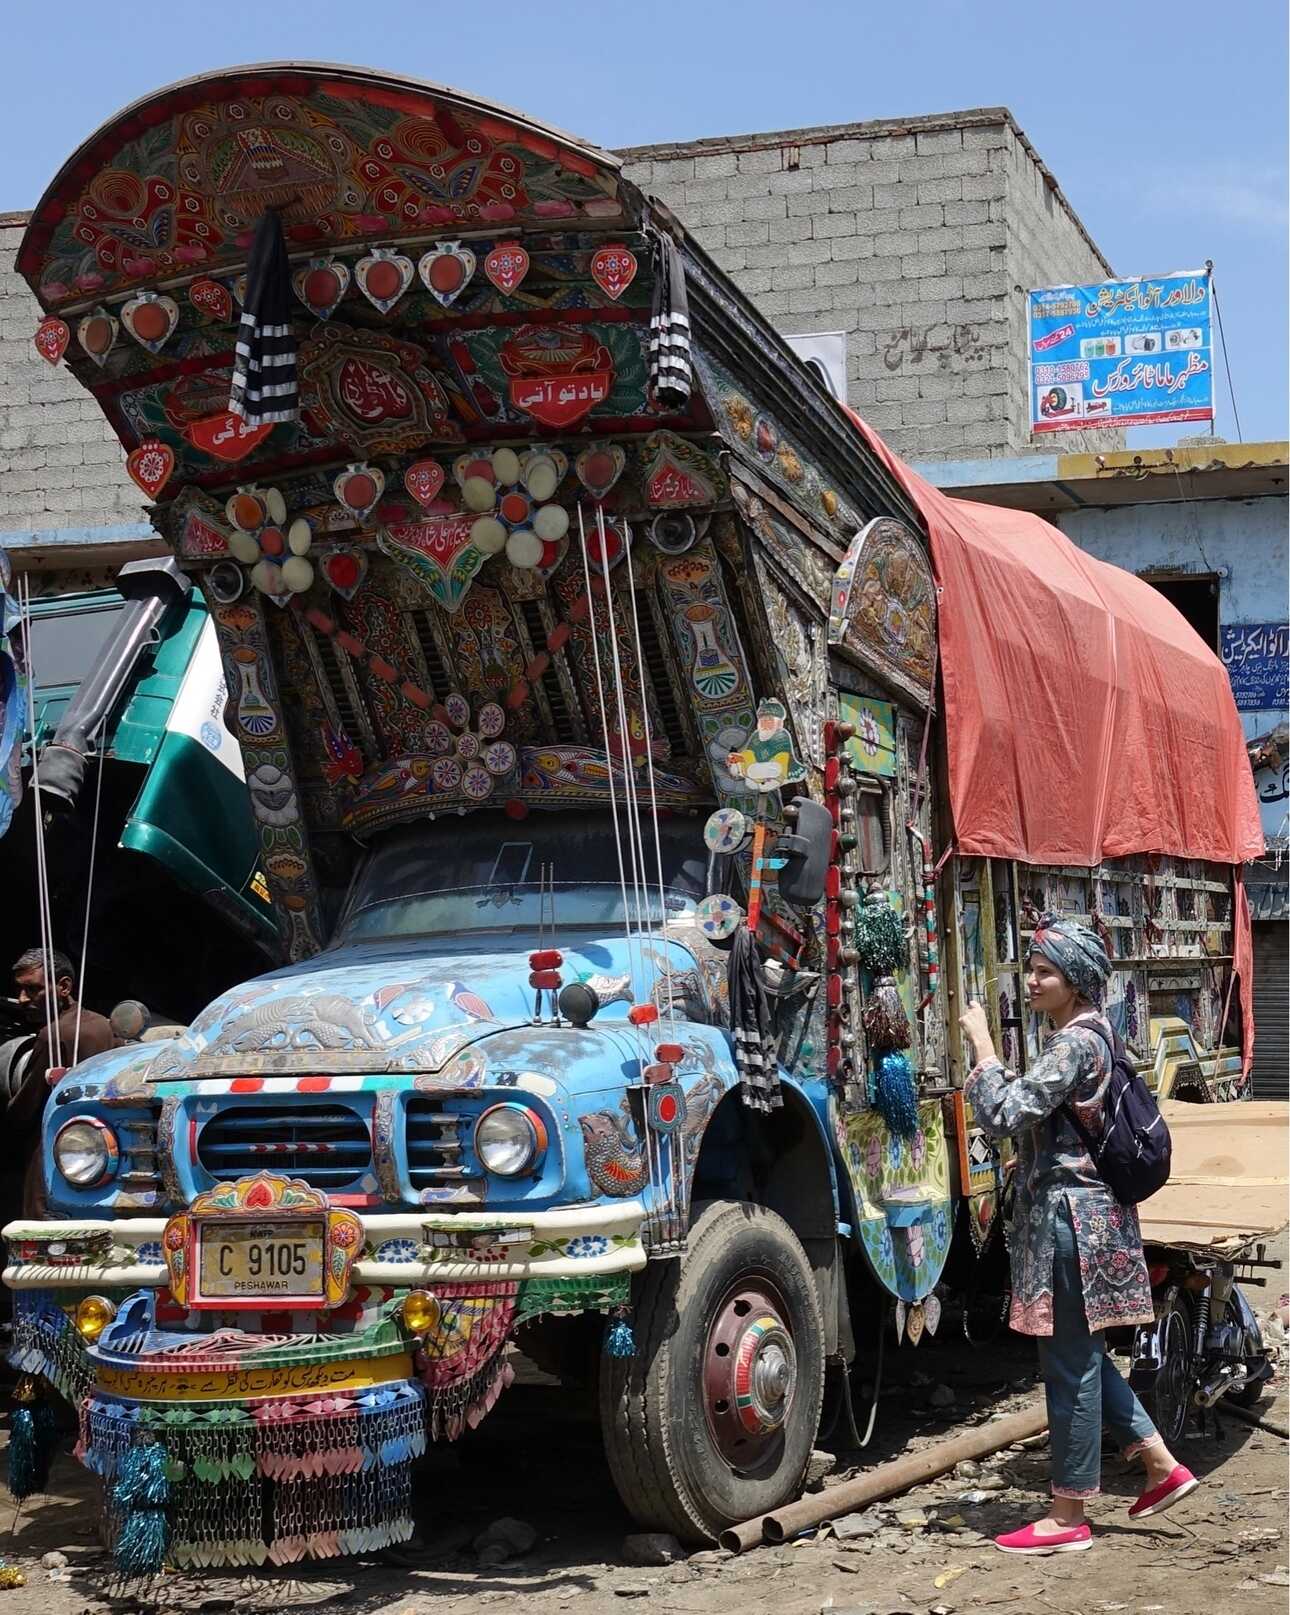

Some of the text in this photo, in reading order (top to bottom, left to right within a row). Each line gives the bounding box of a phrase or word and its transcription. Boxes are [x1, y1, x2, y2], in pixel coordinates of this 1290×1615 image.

[519, 381, 603, 407] یاد تو آتی
[219, 1243, 307, 1276] C 9105
[234, 1280, 289, 1290] PESHAWAR
